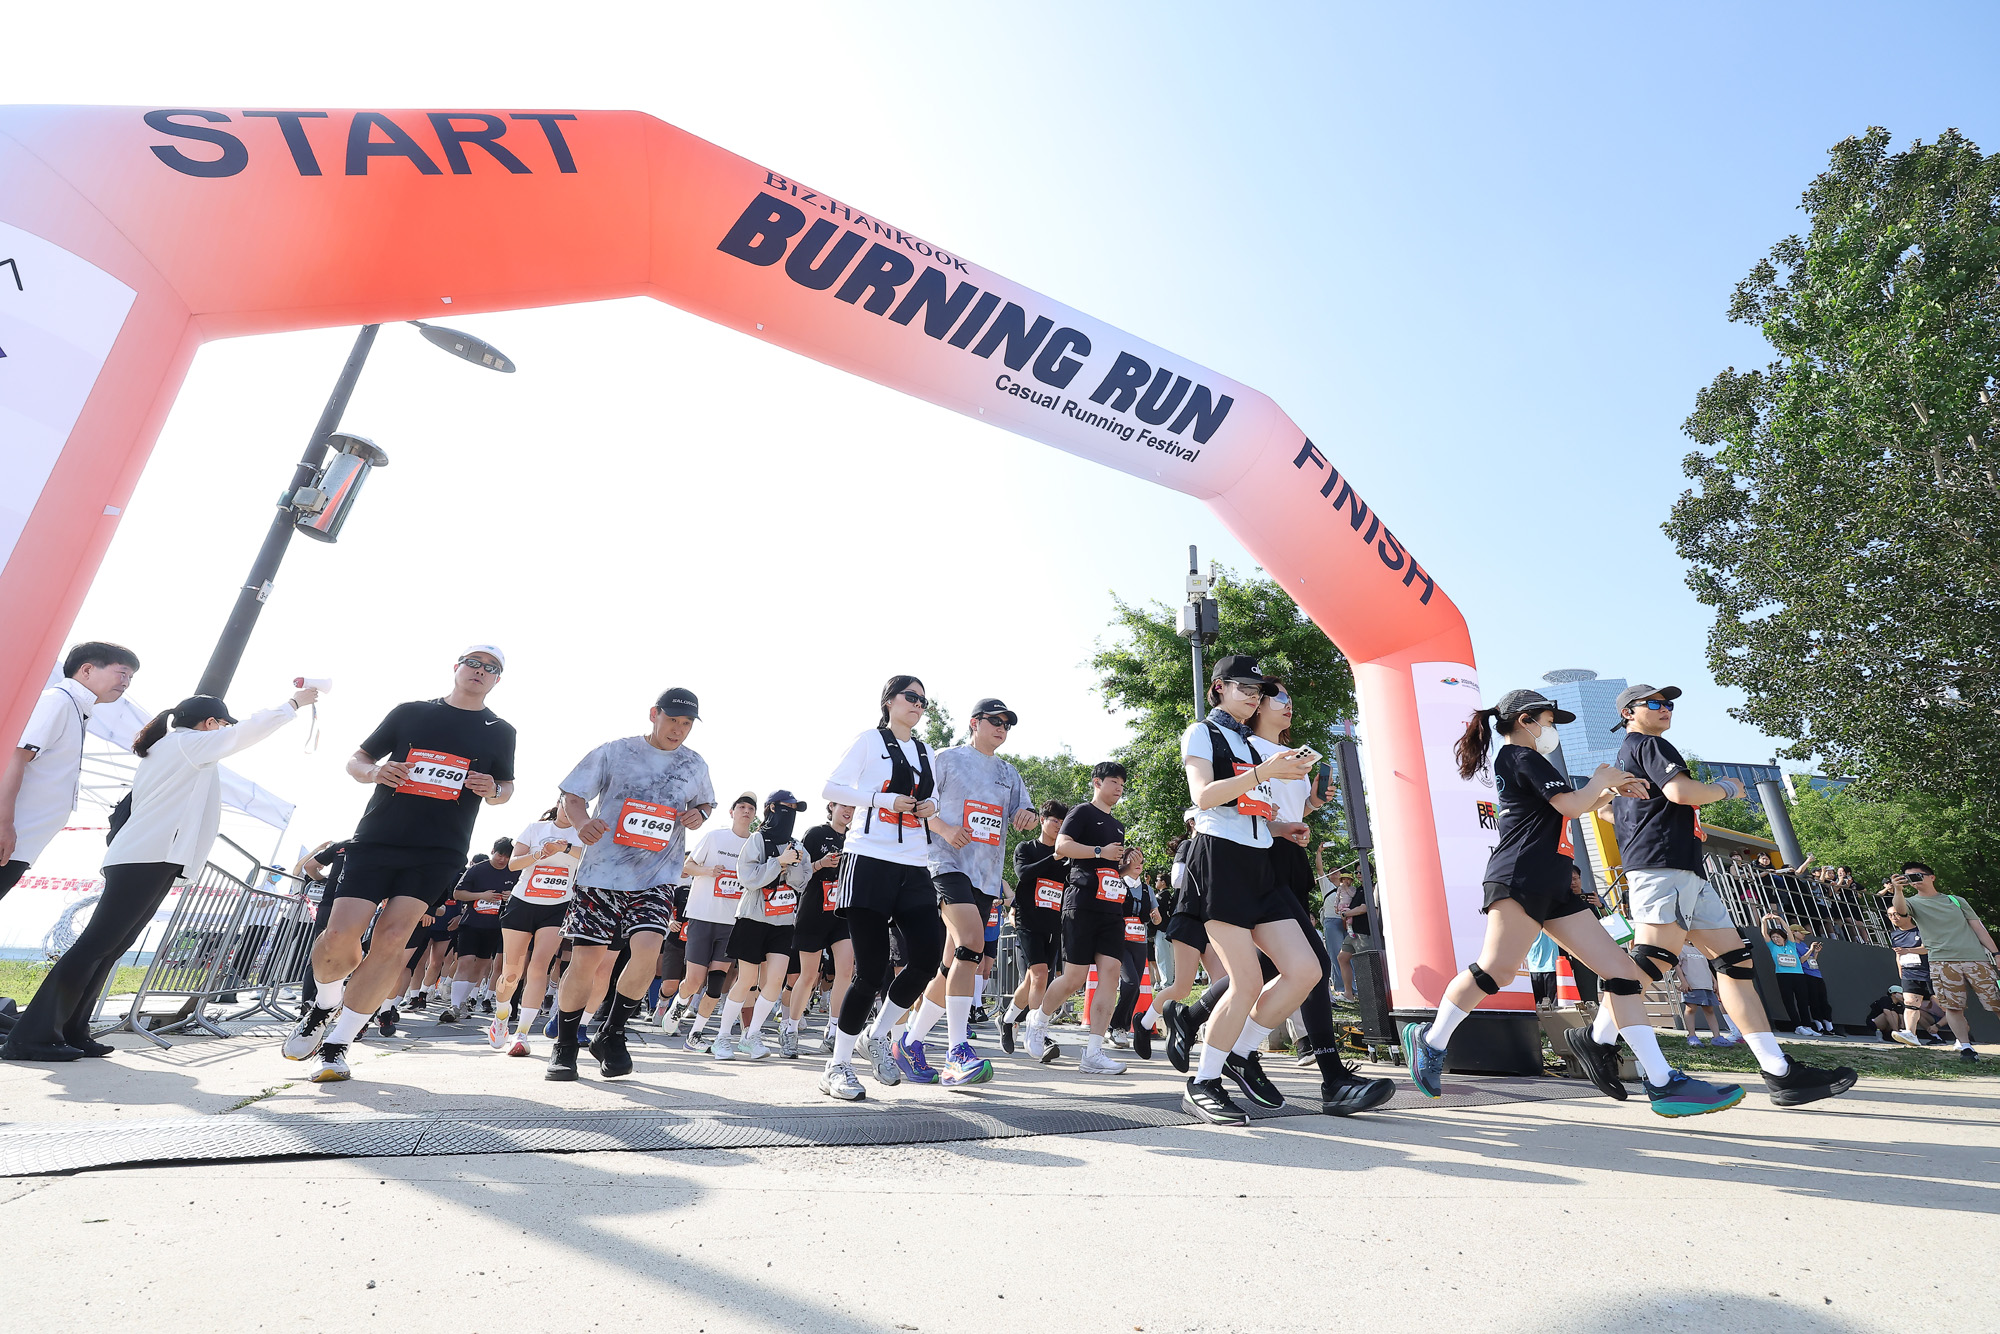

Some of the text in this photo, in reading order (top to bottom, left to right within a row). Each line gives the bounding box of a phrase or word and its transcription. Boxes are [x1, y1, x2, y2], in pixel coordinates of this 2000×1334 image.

[144, 110, 577, 177] START
[763, 171, 969, 276] BIZ.HANKOOK
[717, 192, 1234, 444] BURNING RUN
[995, 374, 1201, 463] Casual Running Festival
[1293, 437, 1434, 606] FINISH
[672, 698, 698, 709] SALOMON
[413, 766, 425, 775] M
[428, 767, 464, 782] 1650
[628, 817, 639, 826] M
[641, 818, 672, 833] 1649
[980, 816, 1002, 828] 2722
[1480, 815, 1500, 831] KIN
[543, 877, 568, 886] 3896
